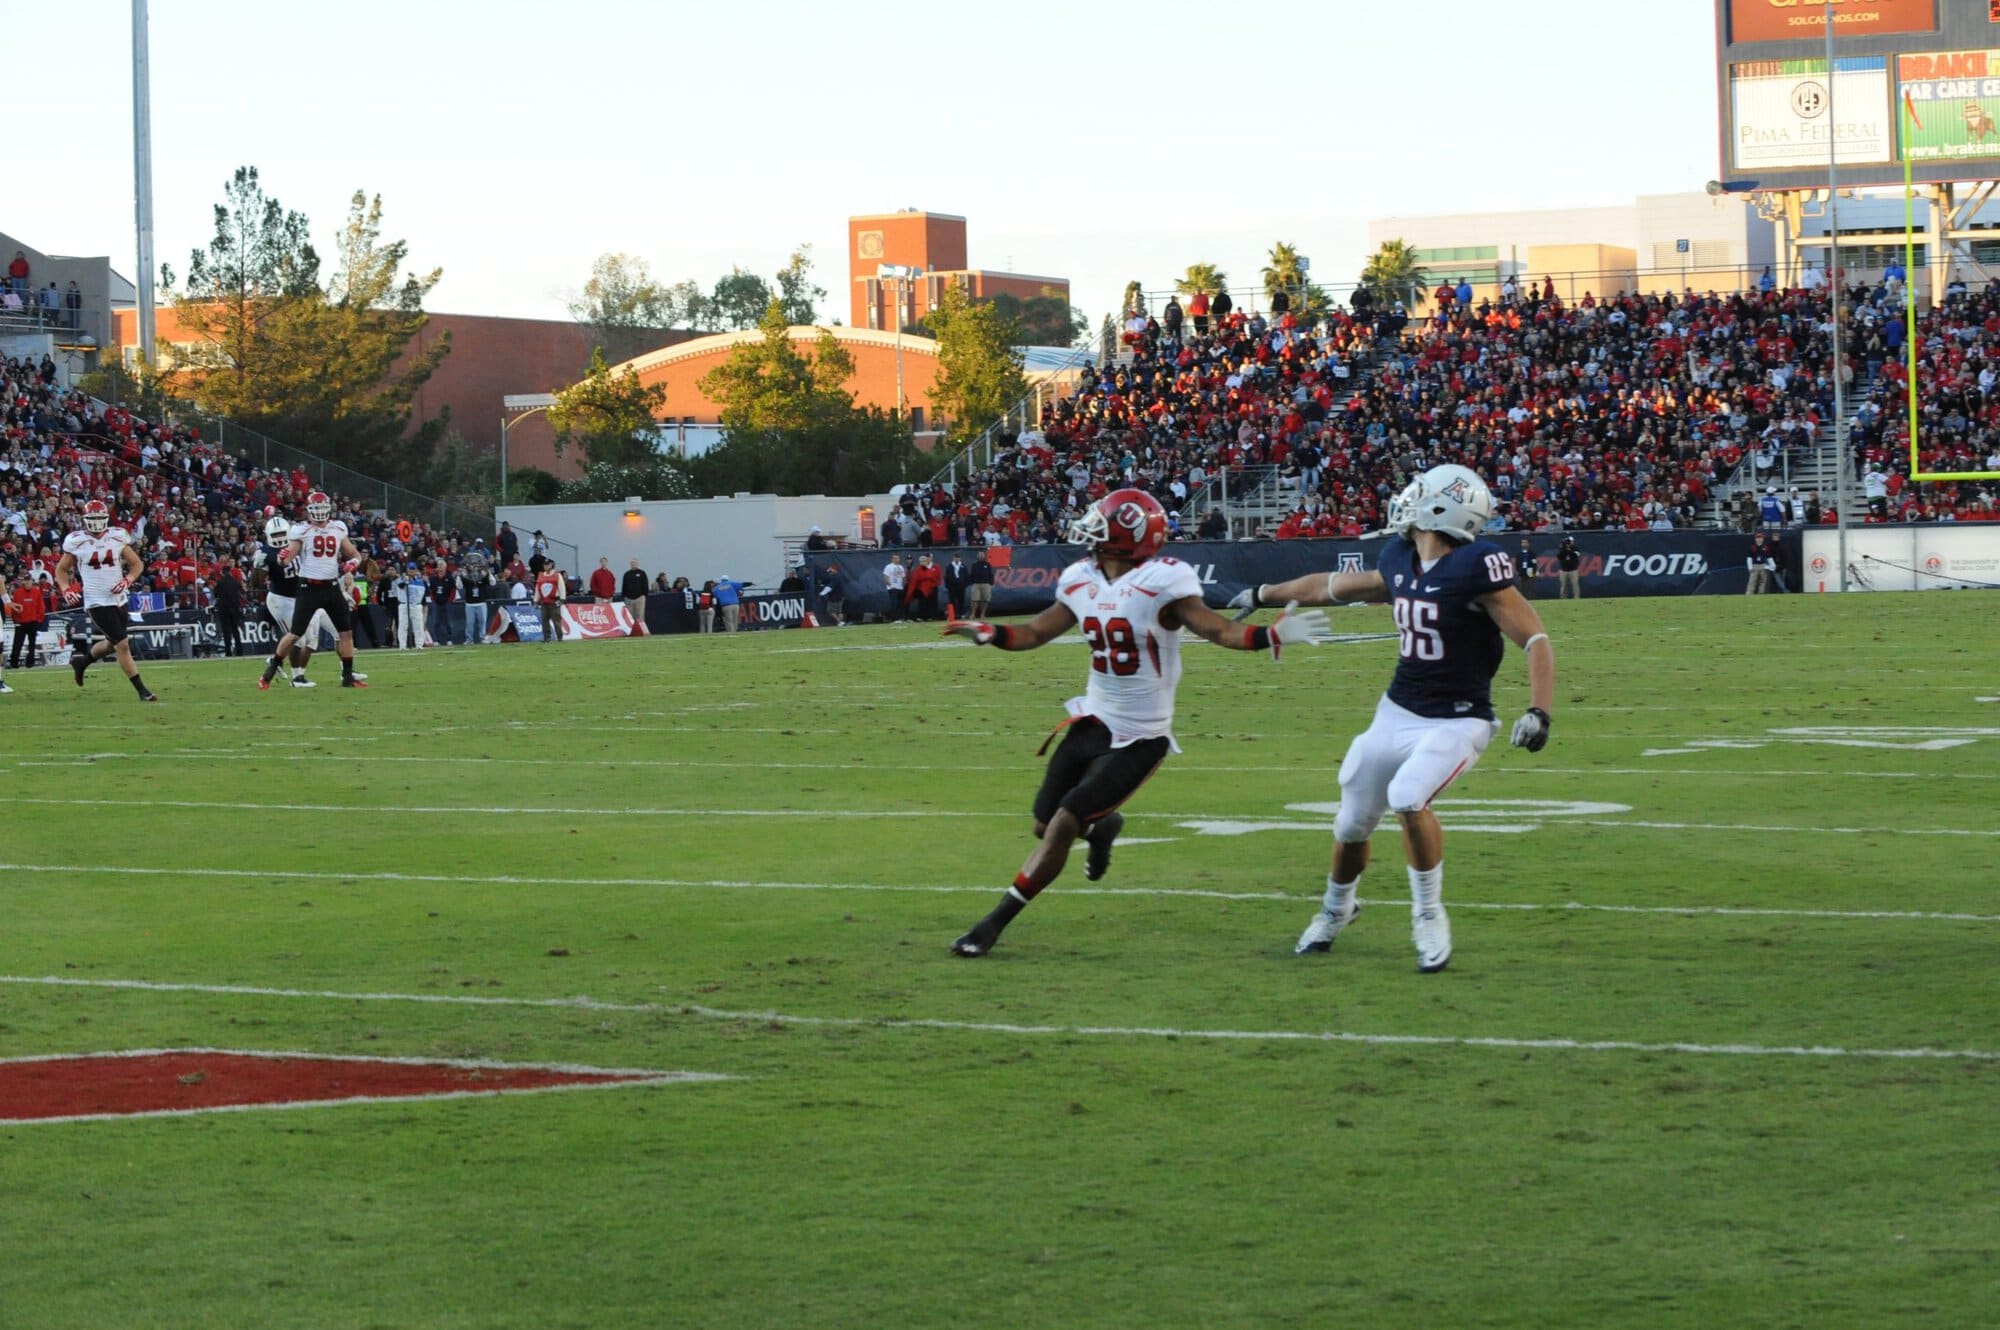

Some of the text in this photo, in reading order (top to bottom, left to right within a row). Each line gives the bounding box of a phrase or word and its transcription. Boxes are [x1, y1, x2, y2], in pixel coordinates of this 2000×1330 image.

[1788, 12, 1880, 26] SOLCASNOS.COM
[1901, 83, 1932, 99] CAR
[1936, 80, 1977, 98] CARE
[313, 535, 336, 557] 99
[88, 549, 115, 570] 44
[1484, 551, 1514, 583] 85
[993, 567, 1061, 589] RIZON
[759, 598, 805, 621] DOWN
[1394, 597, 1444, 661] 85
[1083, 616, 1140, 676] 28
